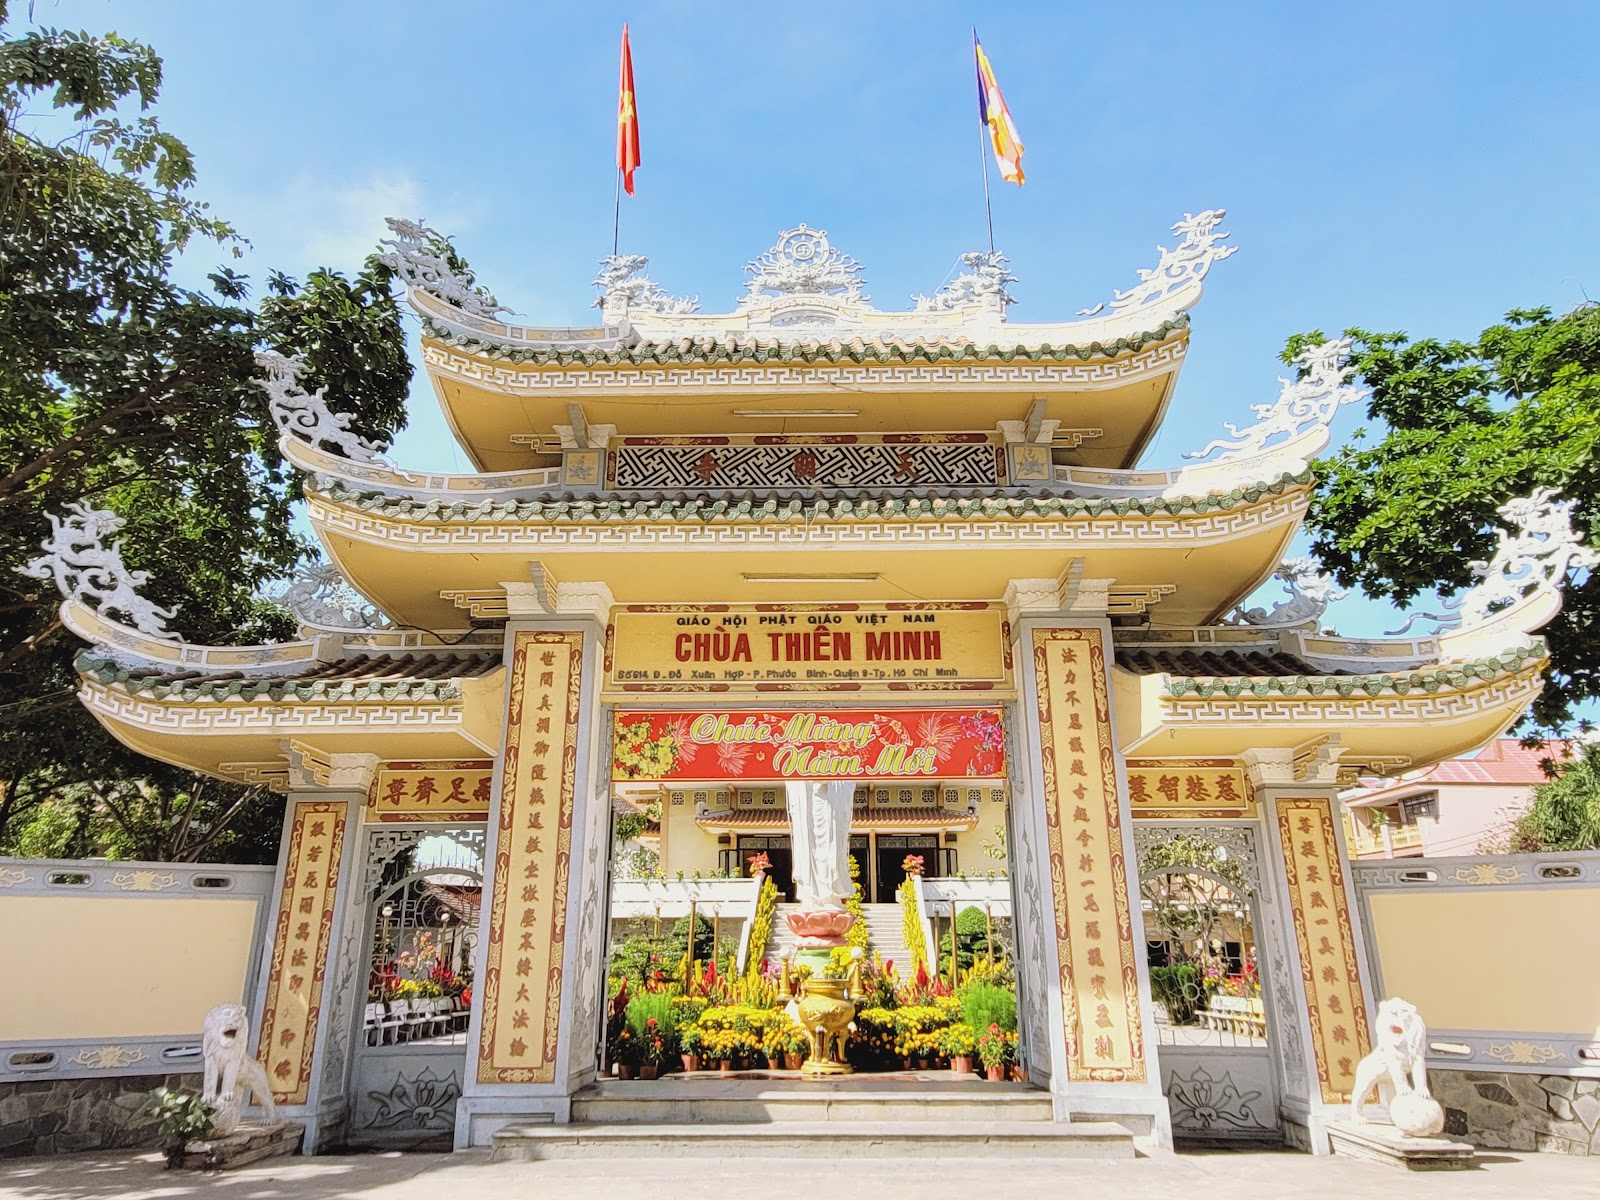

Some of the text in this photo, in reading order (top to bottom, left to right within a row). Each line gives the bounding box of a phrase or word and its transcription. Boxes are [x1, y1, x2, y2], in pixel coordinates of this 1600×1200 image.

[676, 612, 935, 628] GIÁO HỘI PHẬT GIÁO VIỆT NAM
[675, 625, 942, 663] CHÙA THIÊN MINH
[691, 669, 716, 679] Xuân
[766, 668, 797, 678] Phước
[912, 667, 929, 677] Chí
[935, 667, 958, 677] Minh
[690, 713, 876, 747] Chúc Mừng
[773, 745, 938, 775] Năm Mới
